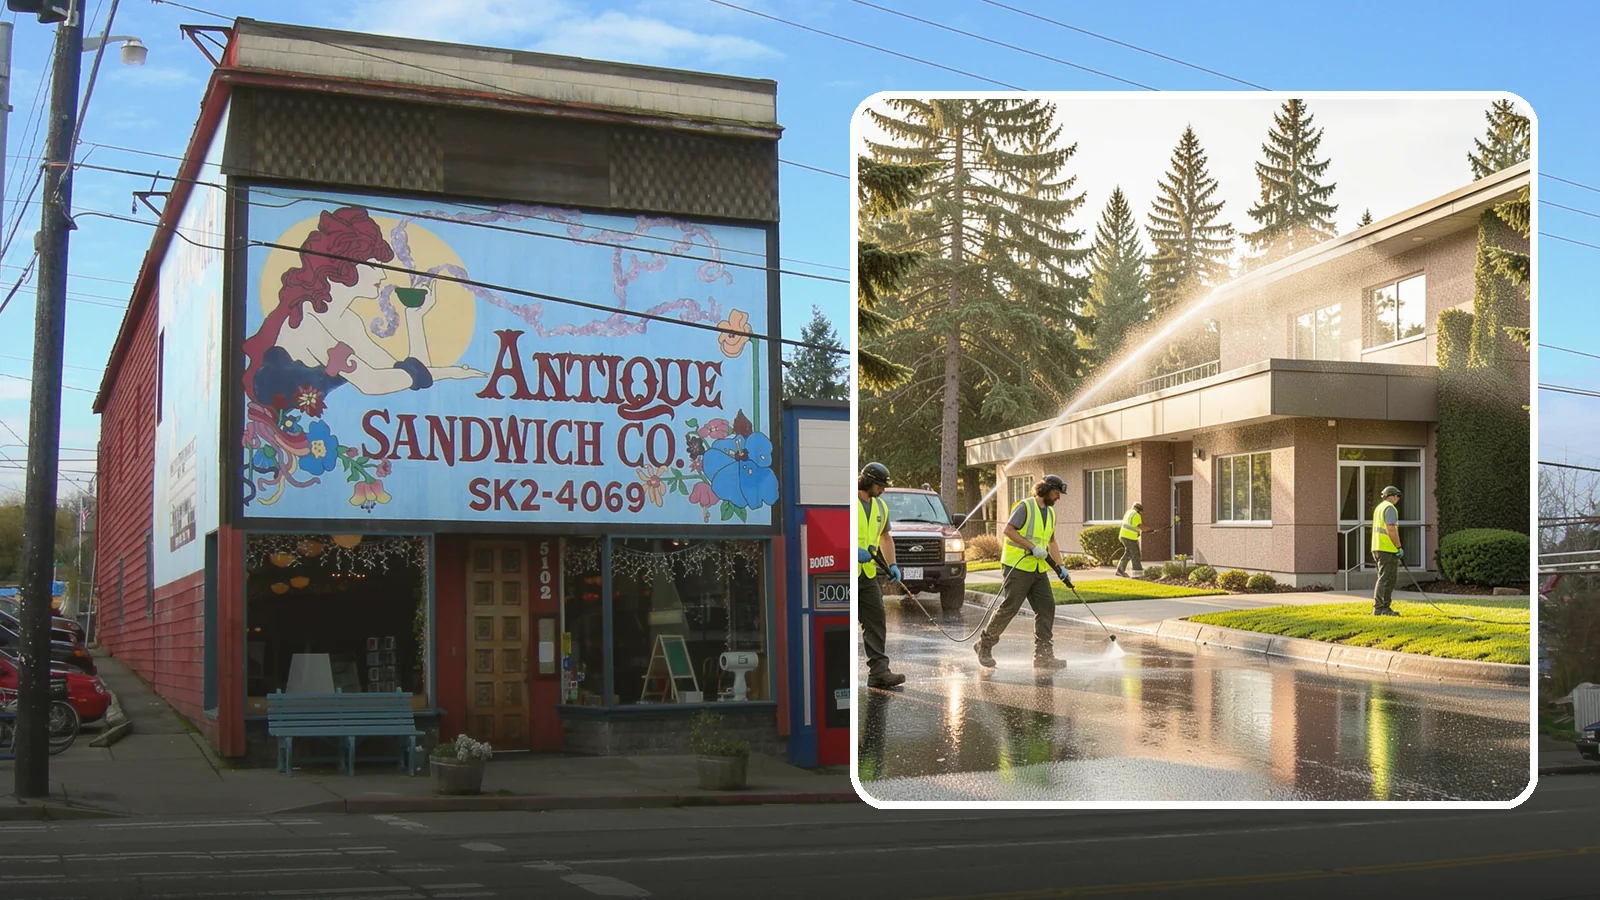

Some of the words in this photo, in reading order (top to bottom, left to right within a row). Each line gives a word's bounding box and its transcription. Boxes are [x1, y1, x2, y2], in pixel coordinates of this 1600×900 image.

[475, 329, 724, 421] ANTIQUE
[361, 408, 605, 468] SANDWICH
[616, 422, 686, 469] CO.
[468, 476, 645, 514] SK2-4069
[539, 541, 552, 600] 5102
[809, 555, 835, 569] BOOKS
